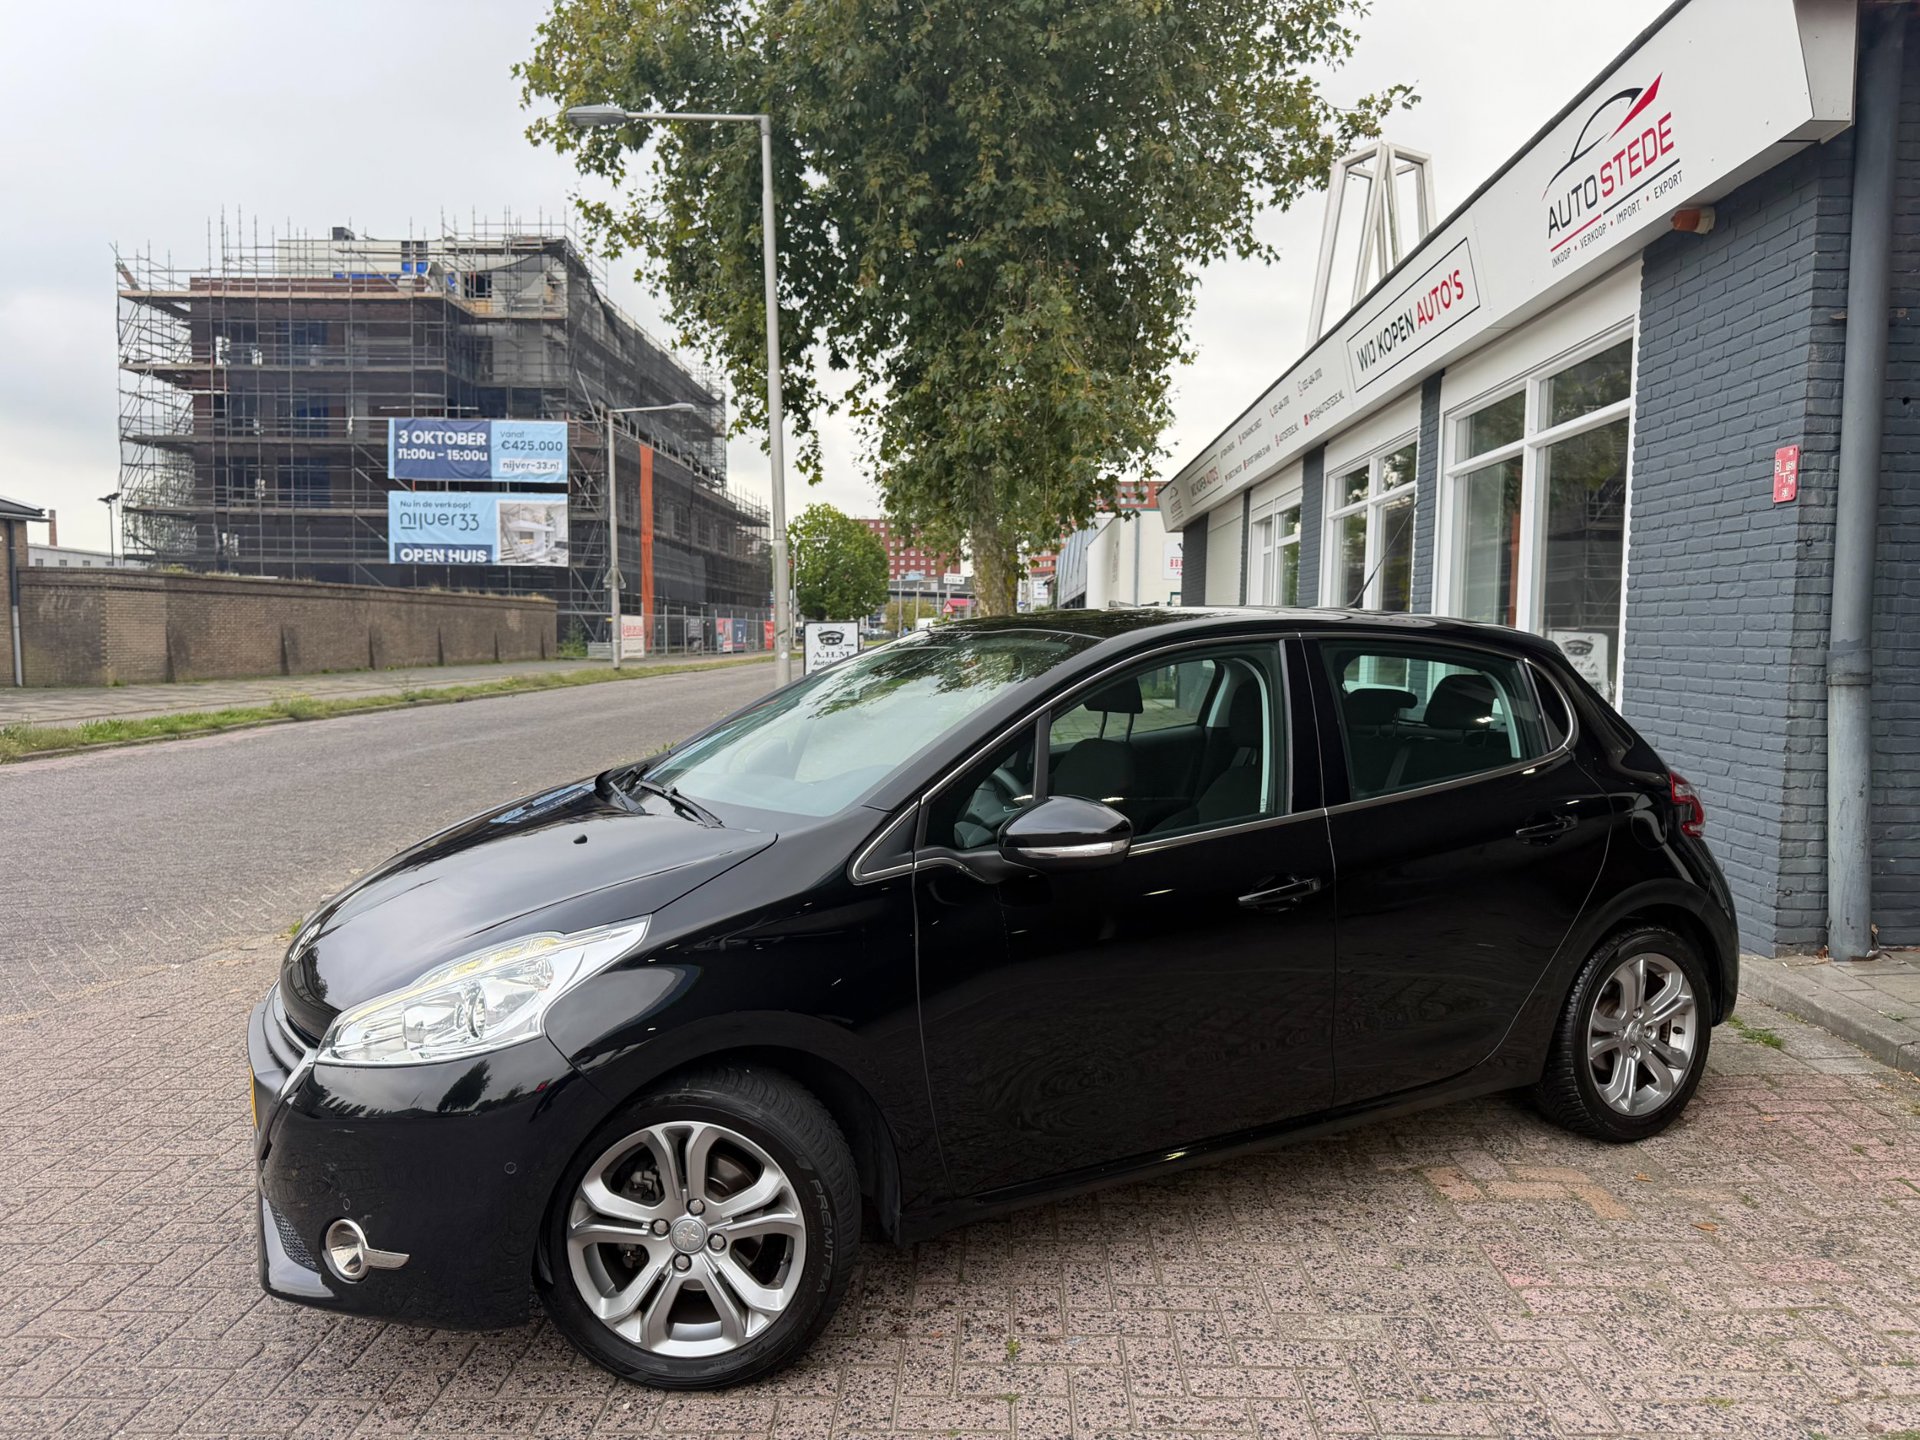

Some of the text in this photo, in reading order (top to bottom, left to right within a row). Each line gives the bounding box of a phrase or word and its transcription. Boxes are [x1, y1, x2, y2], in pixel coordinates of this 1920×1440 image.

[1548, 111, 1675, 239] AUTOSTEDE
[1551, 170, 1683, 268] INKOOP VERKOOP IMPORT EXPORT
[1356, 269, 1464, 372] WIJ KOPEN AUTO'S
[399, 430, 487, 446] 3 OKTOBER
[501, 440, 563, 452] €425.000
[397, 448, 435, 460] 11:00u
[447, 449, 488, 461] 15:00u
[502, 460, 560, 472] nijver-33.nl
[400, 500, 471, 511] Nu in de verkoop!
[400, 548, 487, 563] OPEN HUIS
[810, 1179, 834, 1293] PREMITRA
